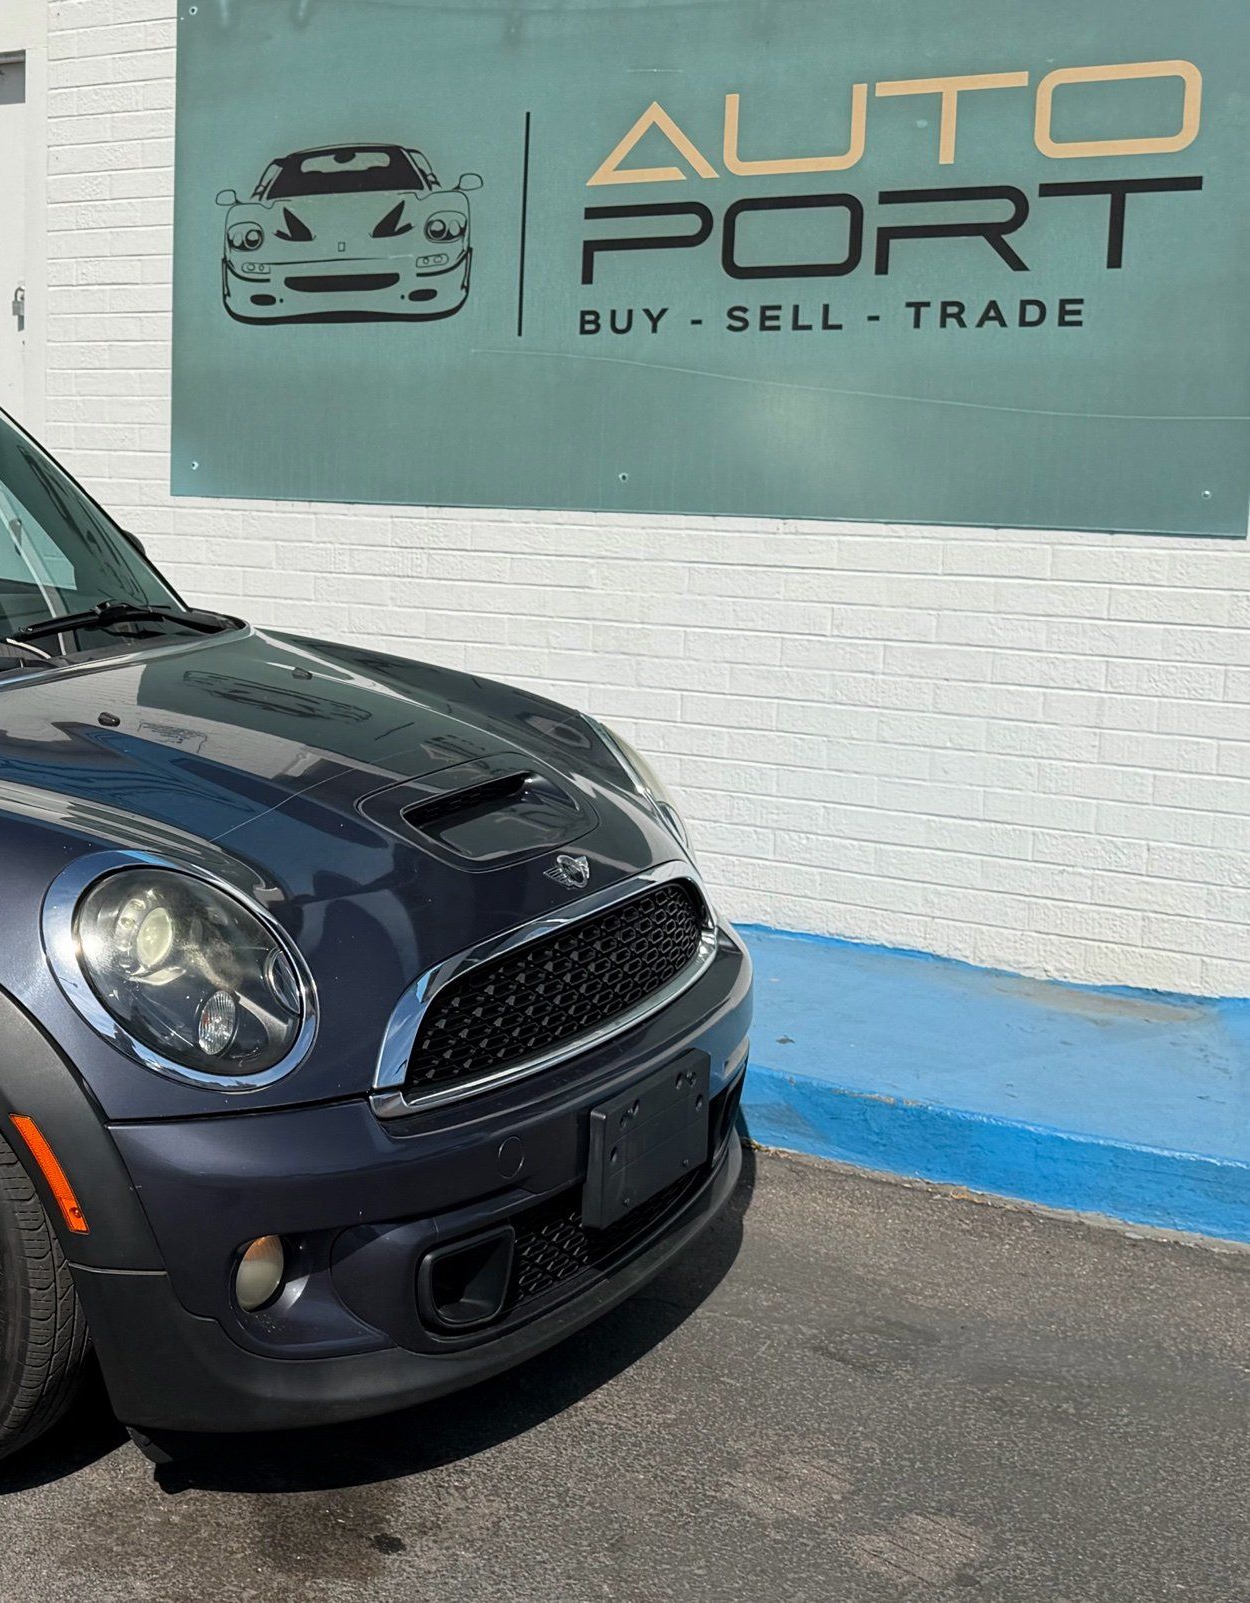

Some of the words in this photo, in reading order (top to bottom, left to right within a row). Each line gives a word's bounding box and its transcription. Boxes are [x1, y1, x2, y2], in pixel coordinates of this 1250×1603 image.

[586, 59, 1203, 187] AUTO
[581, 175, 1204, 285] PORT
[579, 308, 669, 335] BUY
[726, 304, 844, 332] SELL
[905, 298, 1085, 329] TRADE
